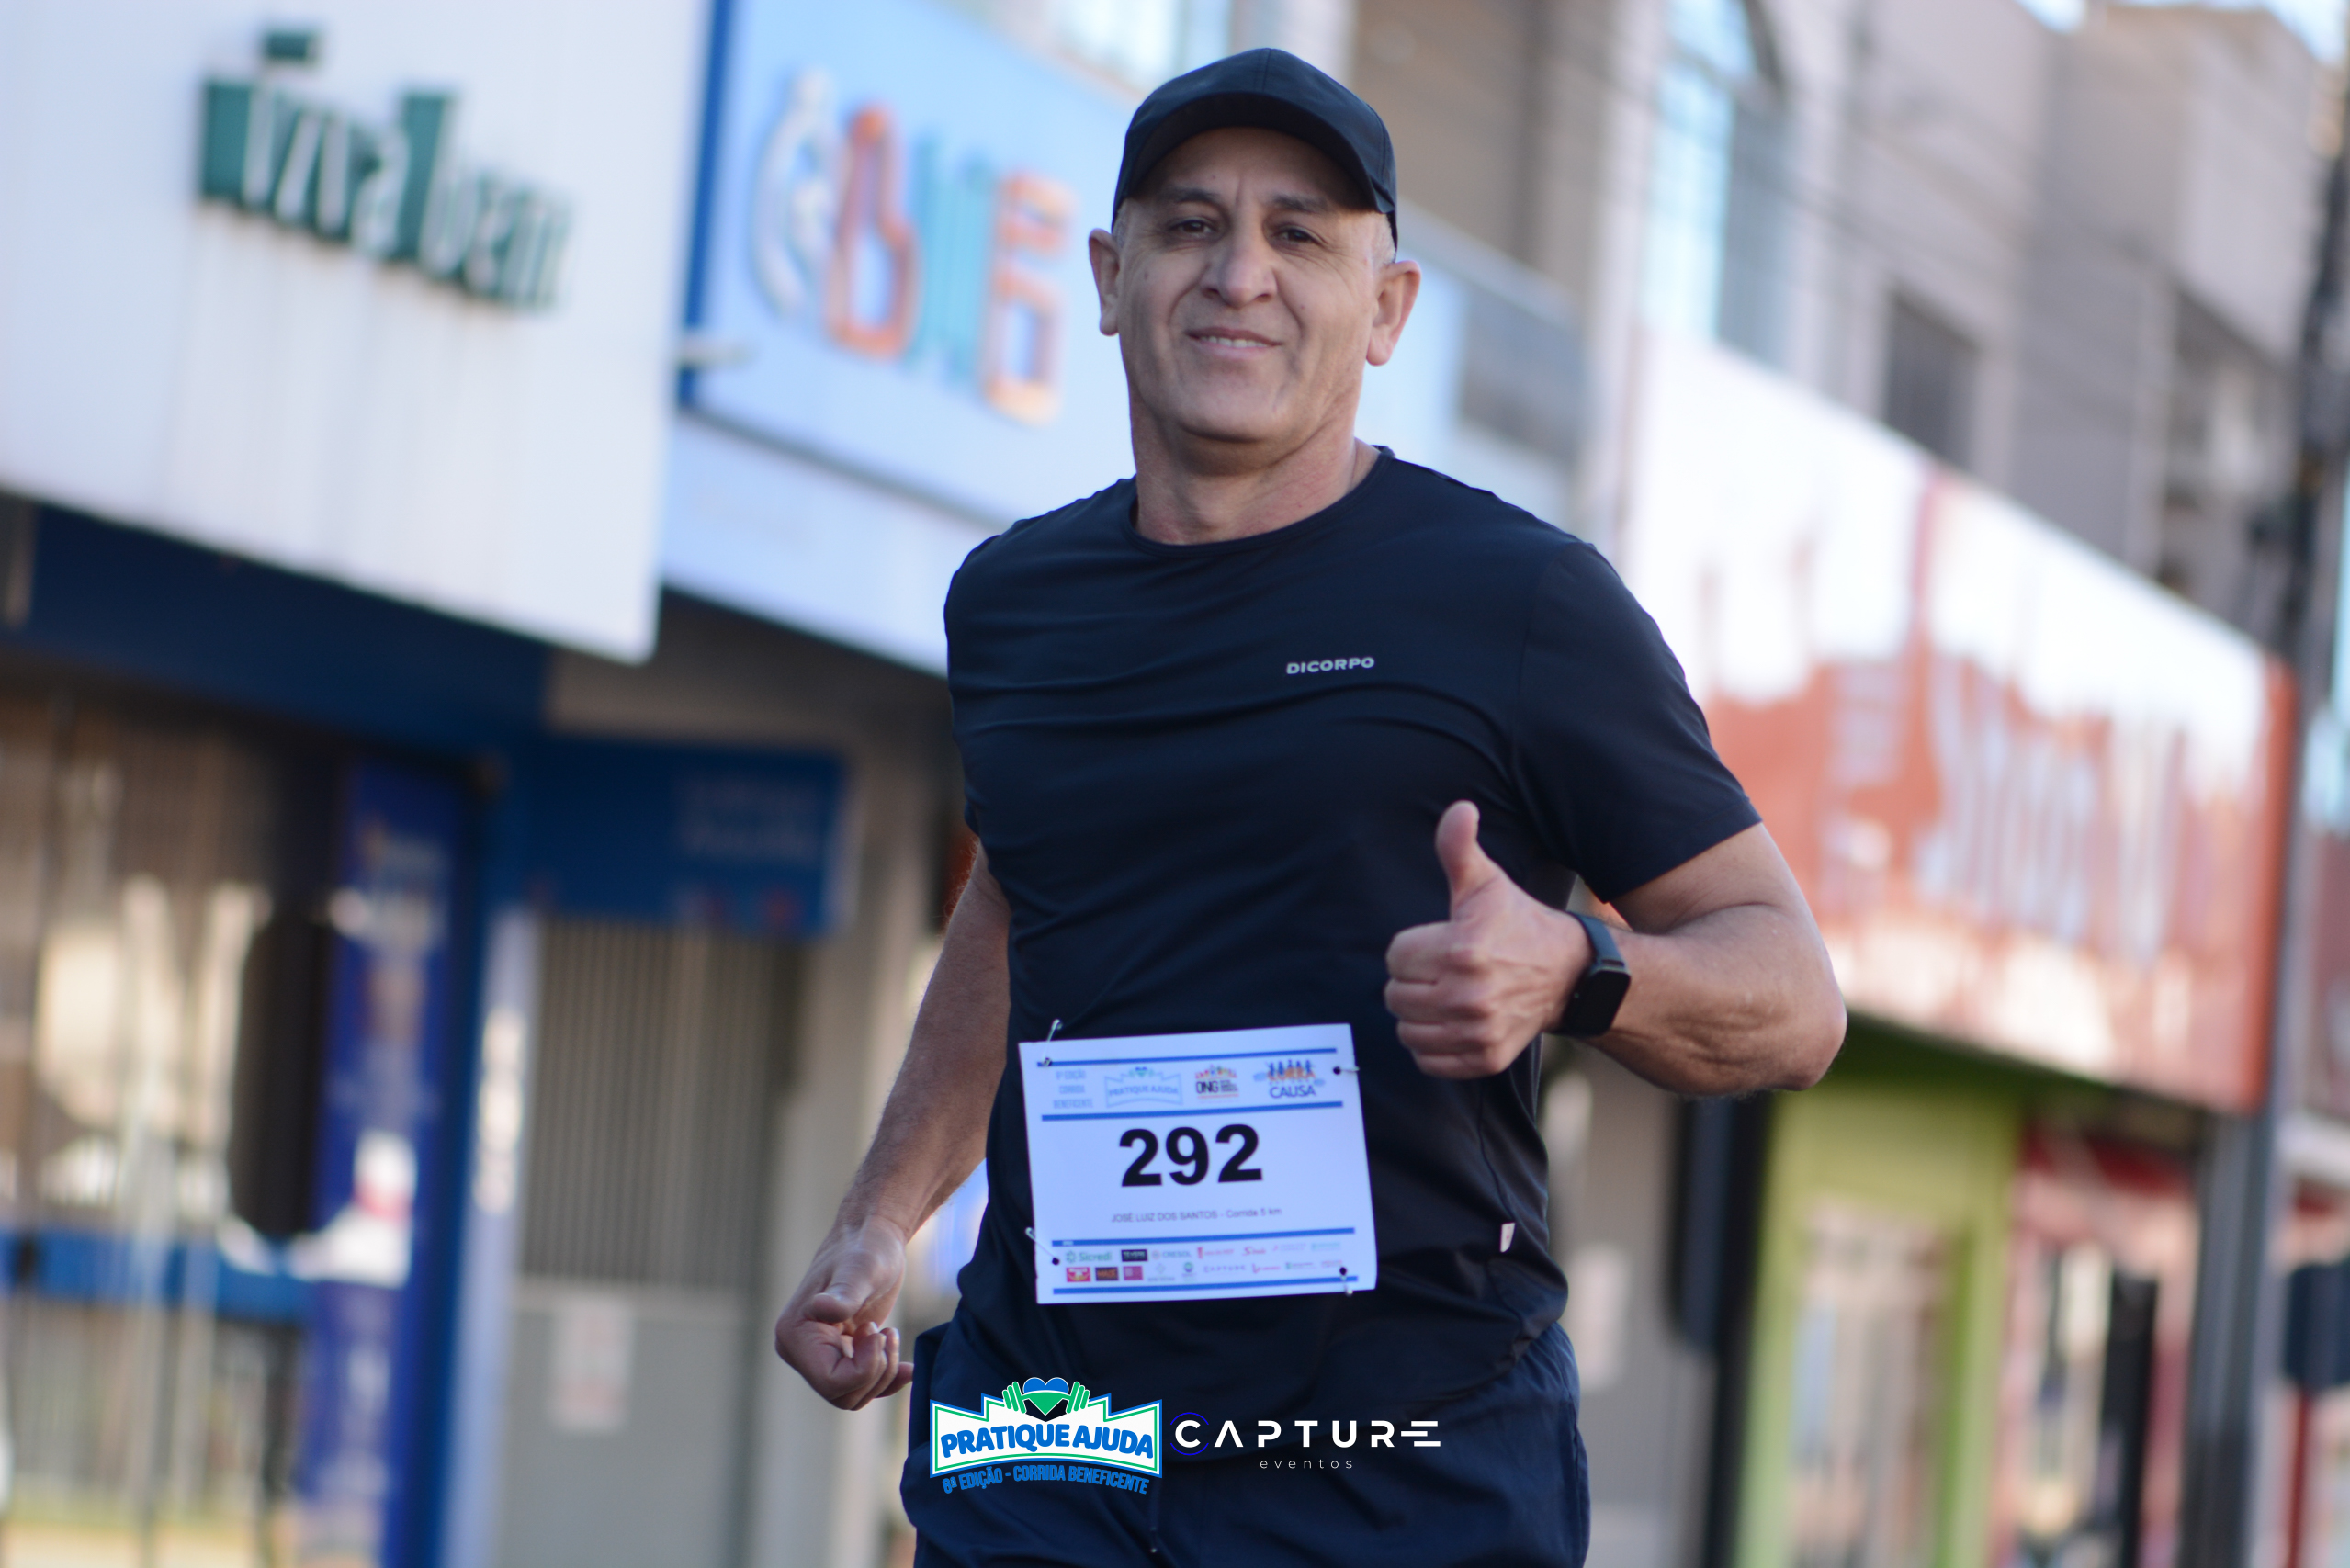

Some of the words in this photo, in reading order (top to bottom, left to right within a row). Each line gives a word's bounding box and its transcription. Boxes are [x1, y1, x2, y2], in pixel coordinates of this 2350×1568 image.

[1286, 657, 1374, 674] DICORPO
[1109, 1085, 1148, 1097] PRATIQUE
[1151, 1085, 1179, 1095] AJUDA
[1196, 1080, 1219, 1094] ONG
[1270, 1085, 1316, 1099] CAUSA
[1119, 1123, 1263, 1188] 292
[1111, 1211, 1134, 1223] JOSÉ
[1136, 1211, 1156, 1222] LUIZ
[1158, 1210, 1178, 1221] DOS
[1180, 1209, 1218, 1221] SANTOS
[1226, 1207, 1259, 1218] Corrida
[1260, 1207, 1267, 1216] 5
[1269, 1206, 1282, 1216] km
